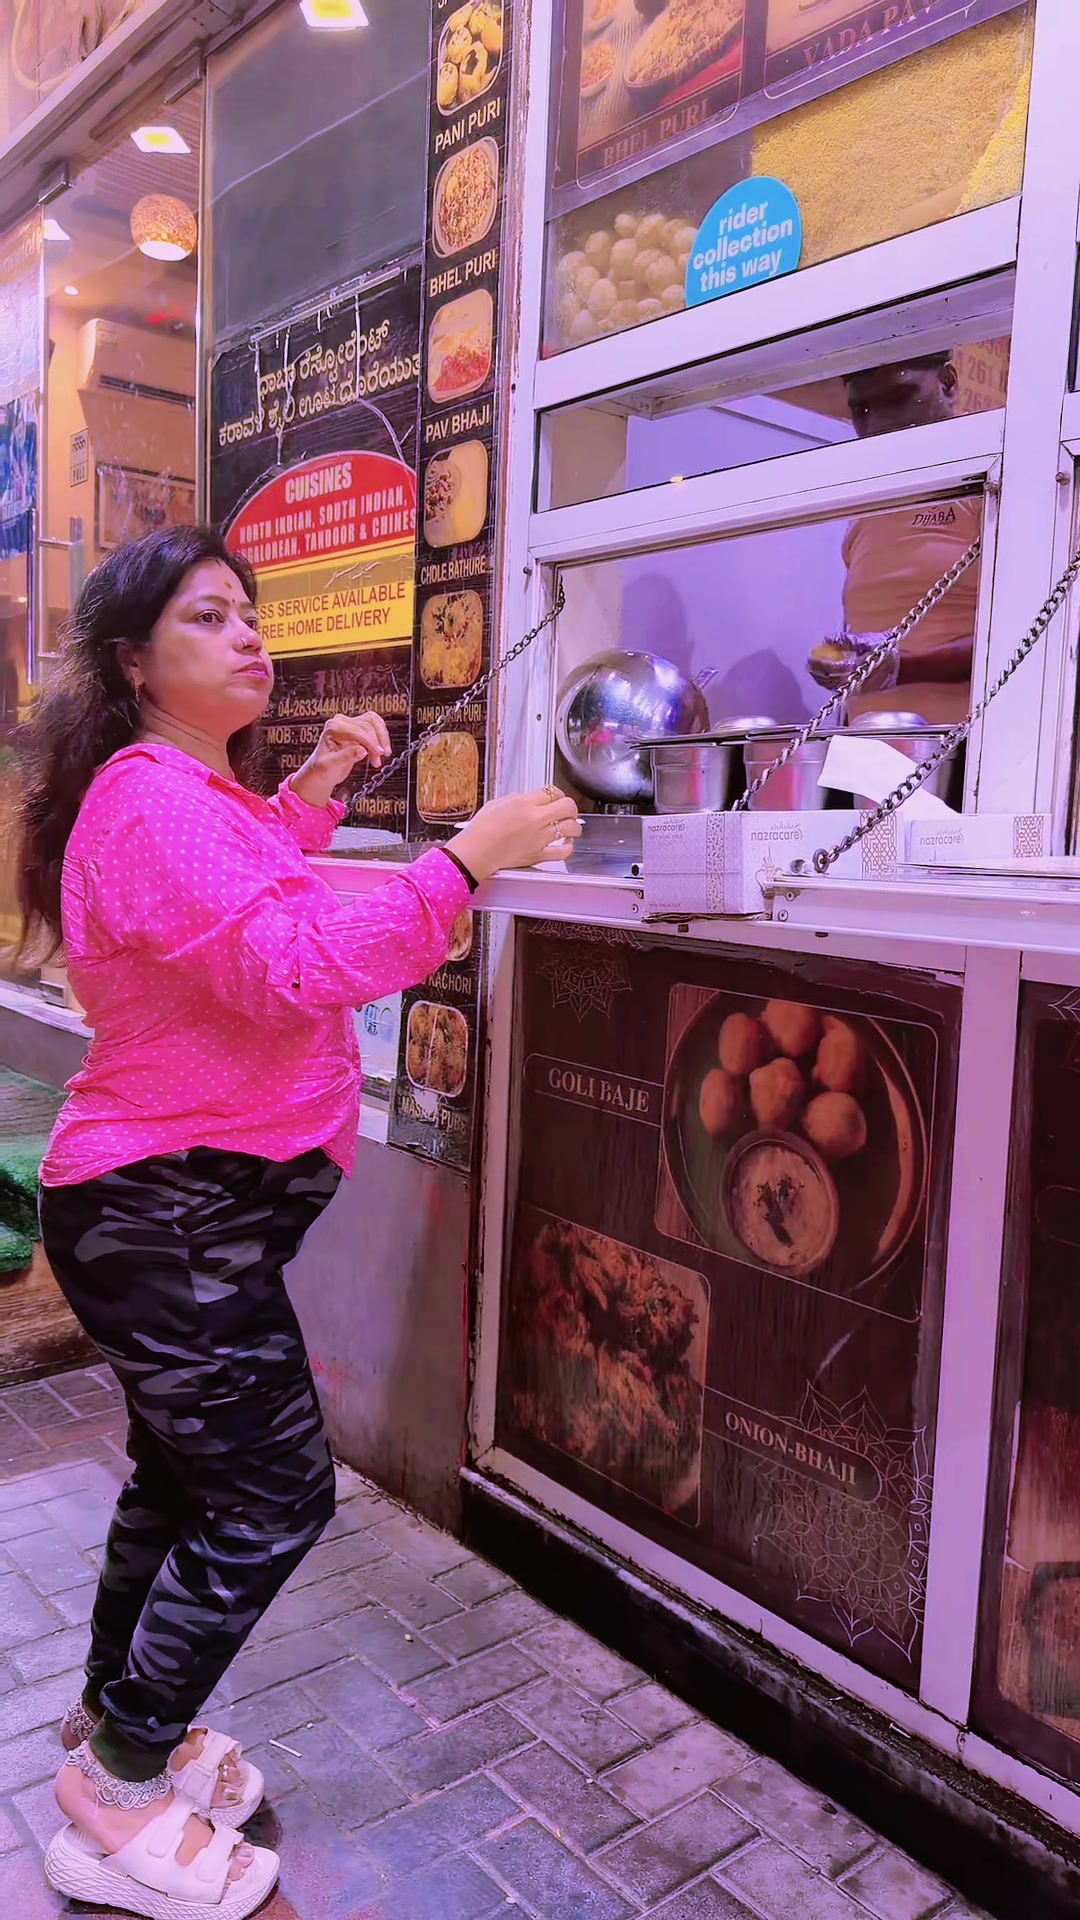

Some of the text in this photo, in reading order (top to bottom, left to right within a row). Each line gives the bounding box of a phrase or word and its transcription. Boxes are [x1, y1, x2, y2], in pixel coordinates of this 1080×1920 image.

[803, 19, 873, 70] VADA
[435, 97, 501, 154] PANI PURI
[604, 99, 708, 166] BHEL PURI
[719, 201, 769, 236] rider
[693, 218, 793, 270] collection
[429, 249, 496, 298] BHEL PURI
[700, 248, 783, 293] this way
[426, 404, 490, 444] PAV BHAJI
[285, 462, 352, 504] CUISINES
[239, 486, 407, 545] NORTH INDIAN, SOUTH INDIAN,
[912, 506, 956, 526] DHABA
[305, 524, 355, 552] TANDOOR
[359, 523, 367, 541] &
[421, 554, 486, 585] CHOLE BATHURE
[278, 595, 329, 617] SERVICE
[332, 582, 406, 610] AVAILABLE
[288, 617, 323, 637] HOME
[327, 607, 391, 632] DELIVERY
[463, 703, 482, 721] PURI
[750, 830, 802, 841] nazracare
[428, 972, 472, 995] KACHORI
[549, 1067, 650, 1113] GOLI BAJE
[725, 1411, 856, 1486] ONION-BHAJI
